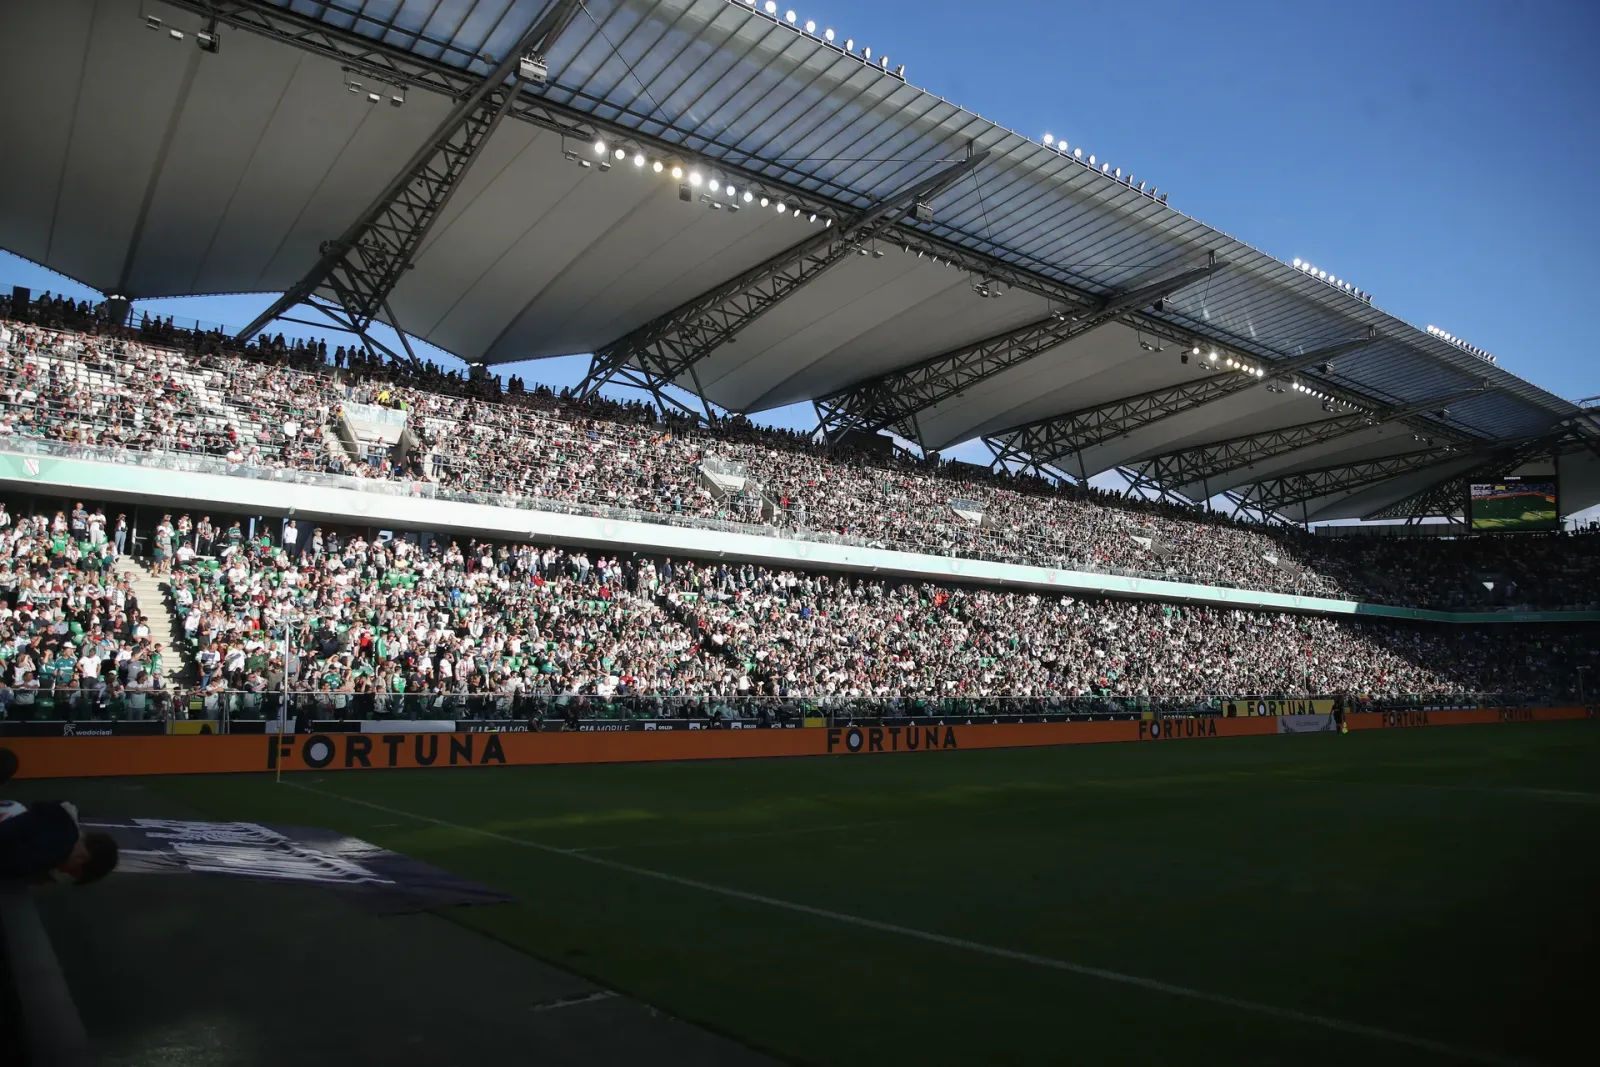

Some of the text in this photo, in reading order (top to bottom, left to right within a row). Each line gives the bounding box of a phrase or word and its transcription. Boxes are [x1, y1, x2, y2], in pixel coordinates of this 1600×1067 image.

[1246, 700, 1315, 717] FORTUNA
[1139, 718, 1217, 739] FORTUNA
[1382, 711, 1429, 728] FORTUNA
[827, 726, 957, 753] FORTUNA
[267, 734, 506, 769] FORTUNA
